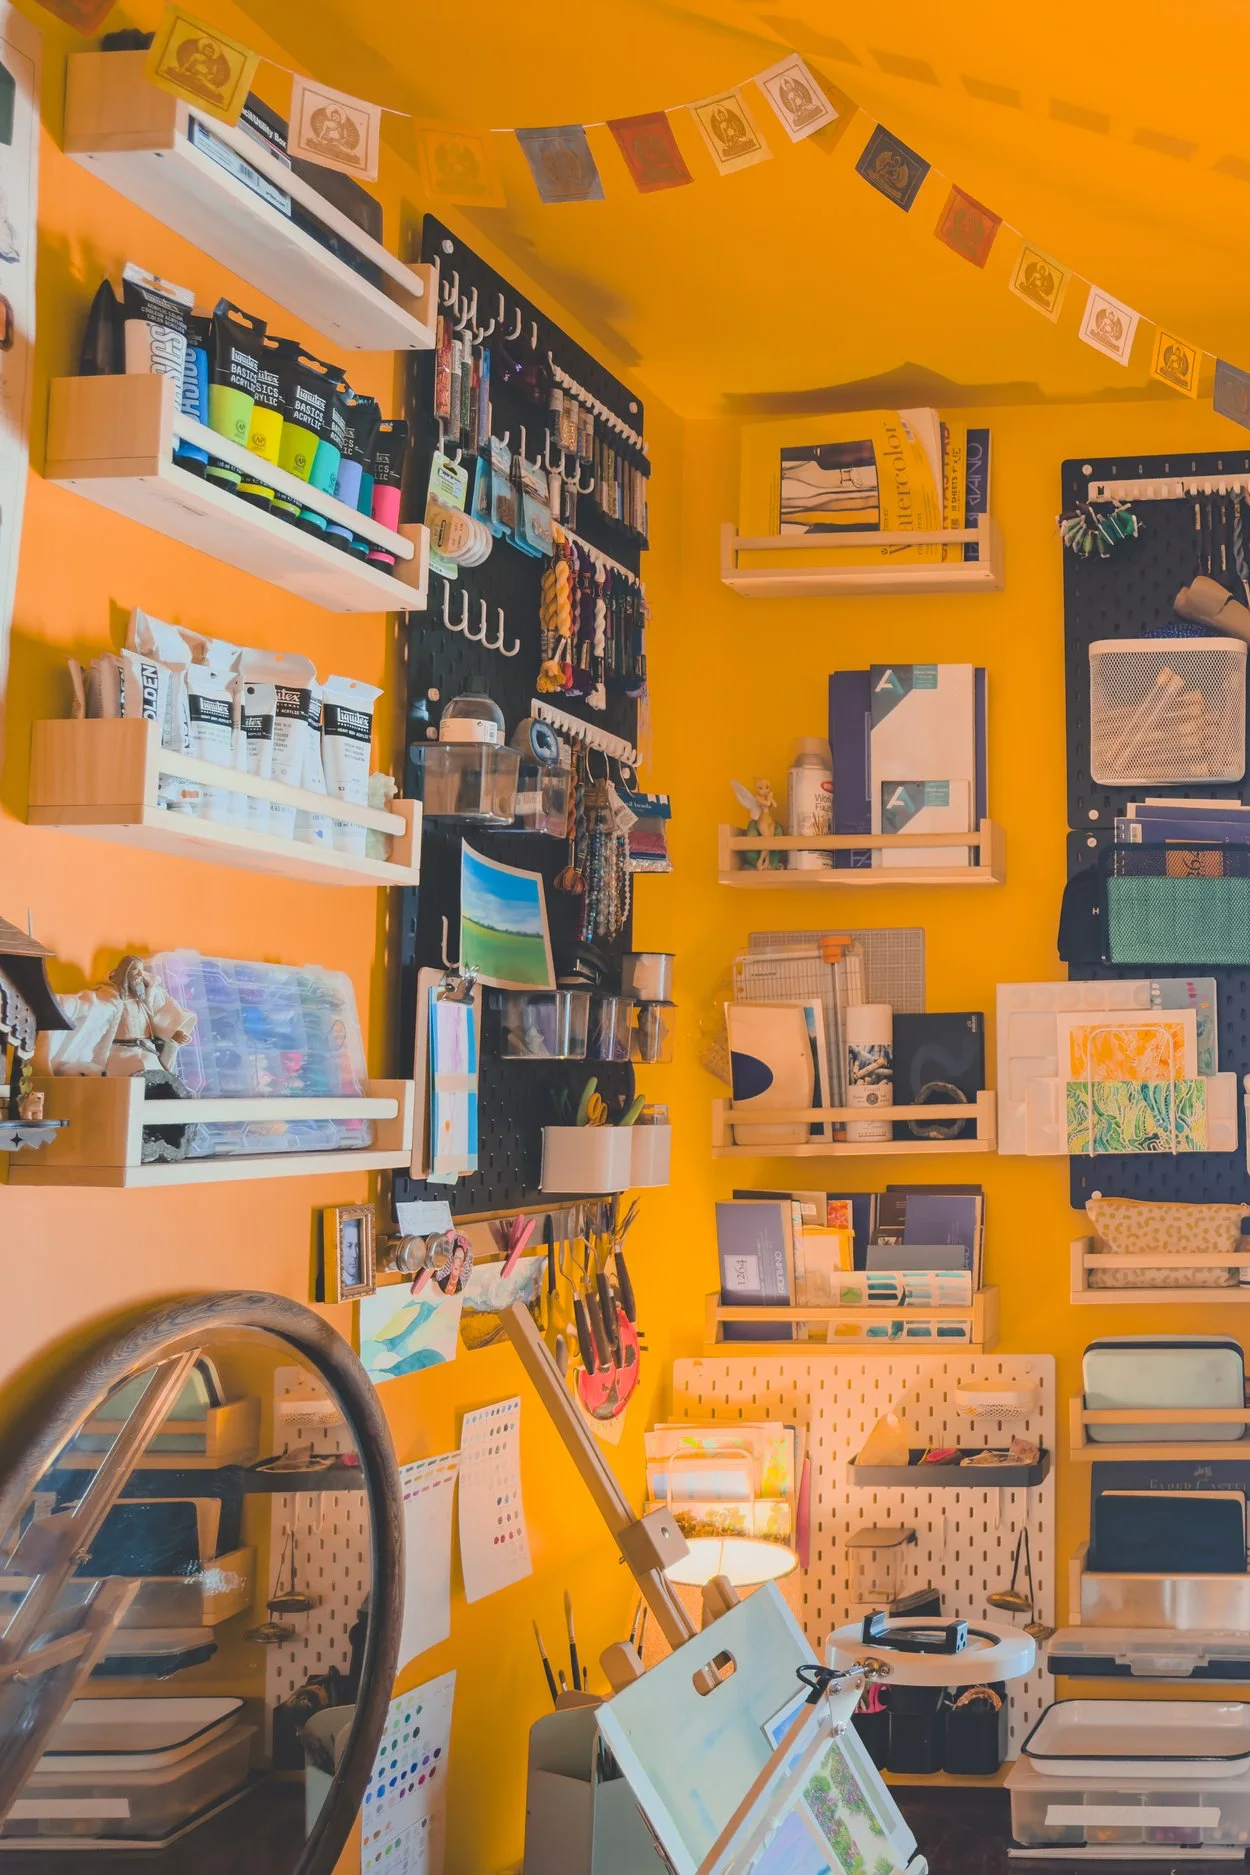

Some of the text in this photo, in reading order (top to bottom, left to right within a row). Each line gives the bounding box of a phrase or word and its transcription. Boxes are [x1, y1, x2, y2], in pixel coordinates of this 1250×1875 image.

[274, 131, 287, 147] Box
[231, 347, 259, 372] Liquitex
[258, 370, 279, 386] itex
[256, 382, 279, 398] SICS
[296, 385, 327, 411] Liquitex
[254, 392, 278, 407] RYLIC
[293, 410, 322, 430] ACRYLIC
[294, 401, 324, 422] BASICS
[141, 662, 159, 720] OLDEN
[275, 688, 301, 704] itex
[200, 698, 229, 715] Liquitex
[242, 717, 263, 728] itex
[337, 708, 369, 729] Liquitex
[735, 1259, 748, 1285] 1264
